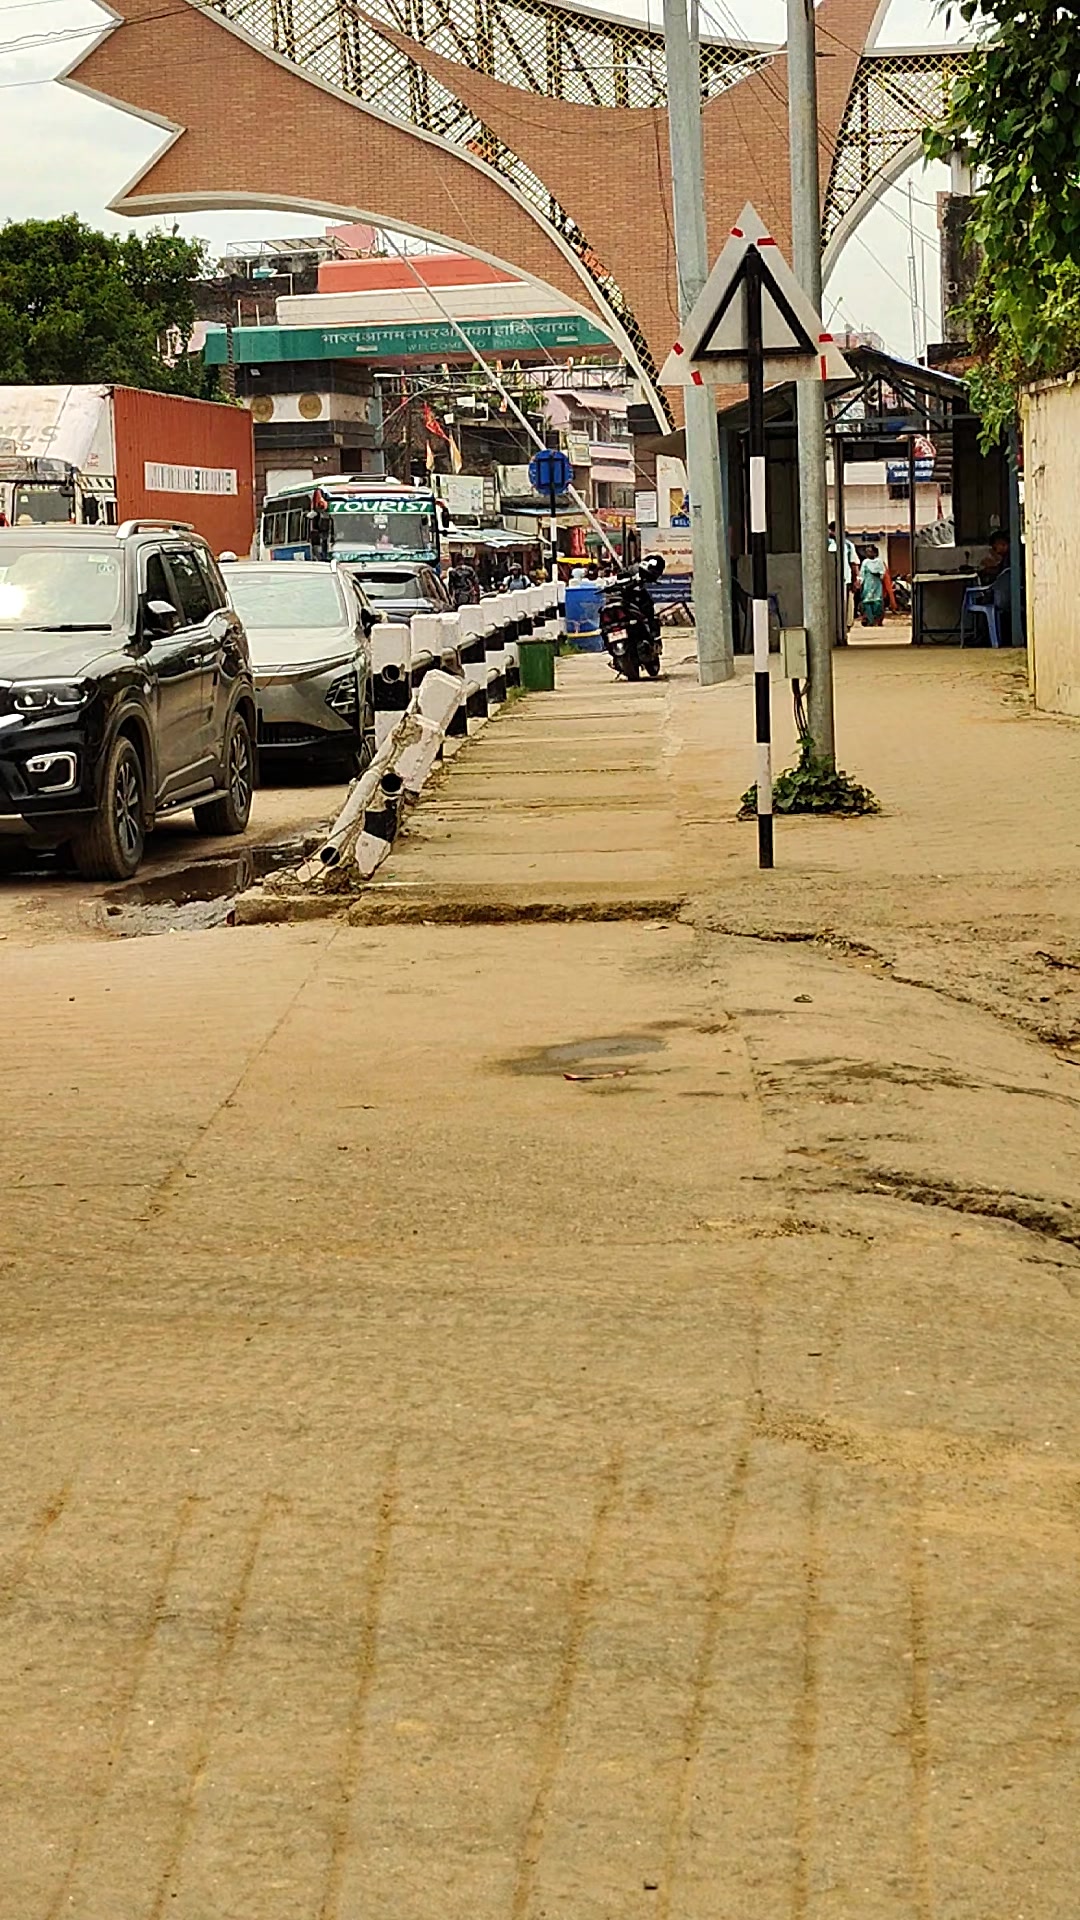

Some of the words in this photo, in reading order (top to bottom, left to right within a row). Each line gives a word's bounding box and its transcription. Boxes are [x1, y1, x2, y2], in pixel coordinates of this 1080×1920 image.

[322, 332, 360, 344] भारत
[362, 330, 417, 342] आगमन
[418, 328, 439, 340] पर
[408, 341, 463, 352] WELCOME
[493, 339, 523, 349] INDIA
[330, 500, 432, 513] TOURIST
